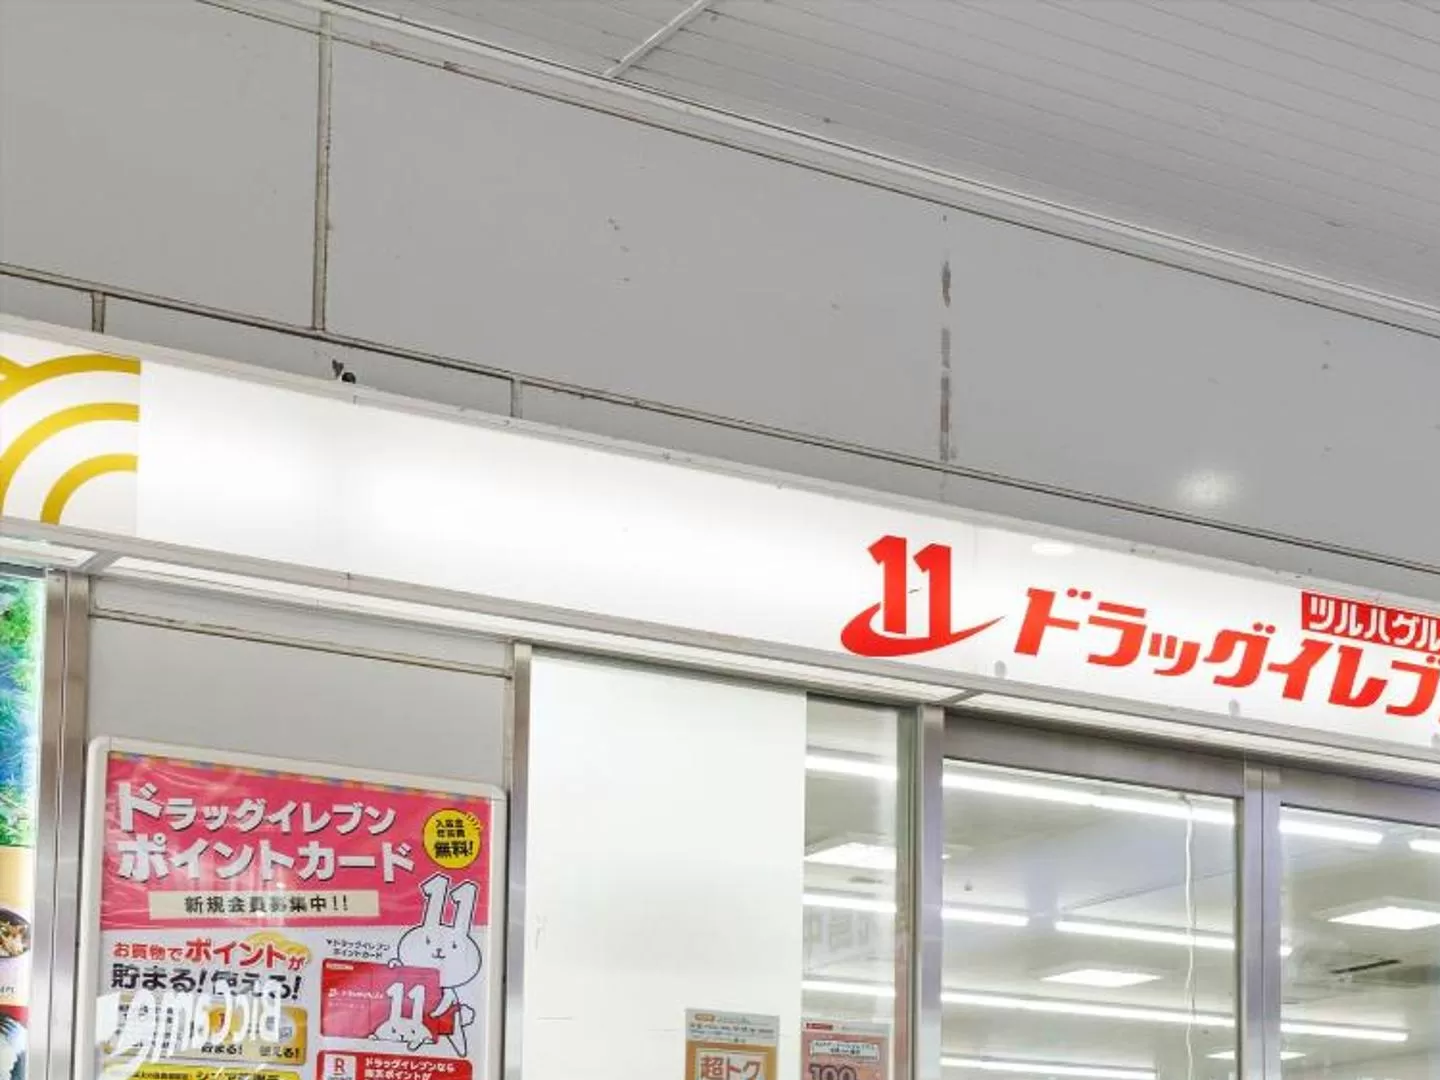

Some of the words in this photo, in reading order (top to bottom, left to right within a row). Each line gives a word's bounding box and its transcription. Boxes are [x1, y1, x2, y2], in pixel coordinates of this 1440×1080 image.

[118, 782, 397, 836] ドラッグイレブン
[117, 833, 415, 883] ポイントカード
